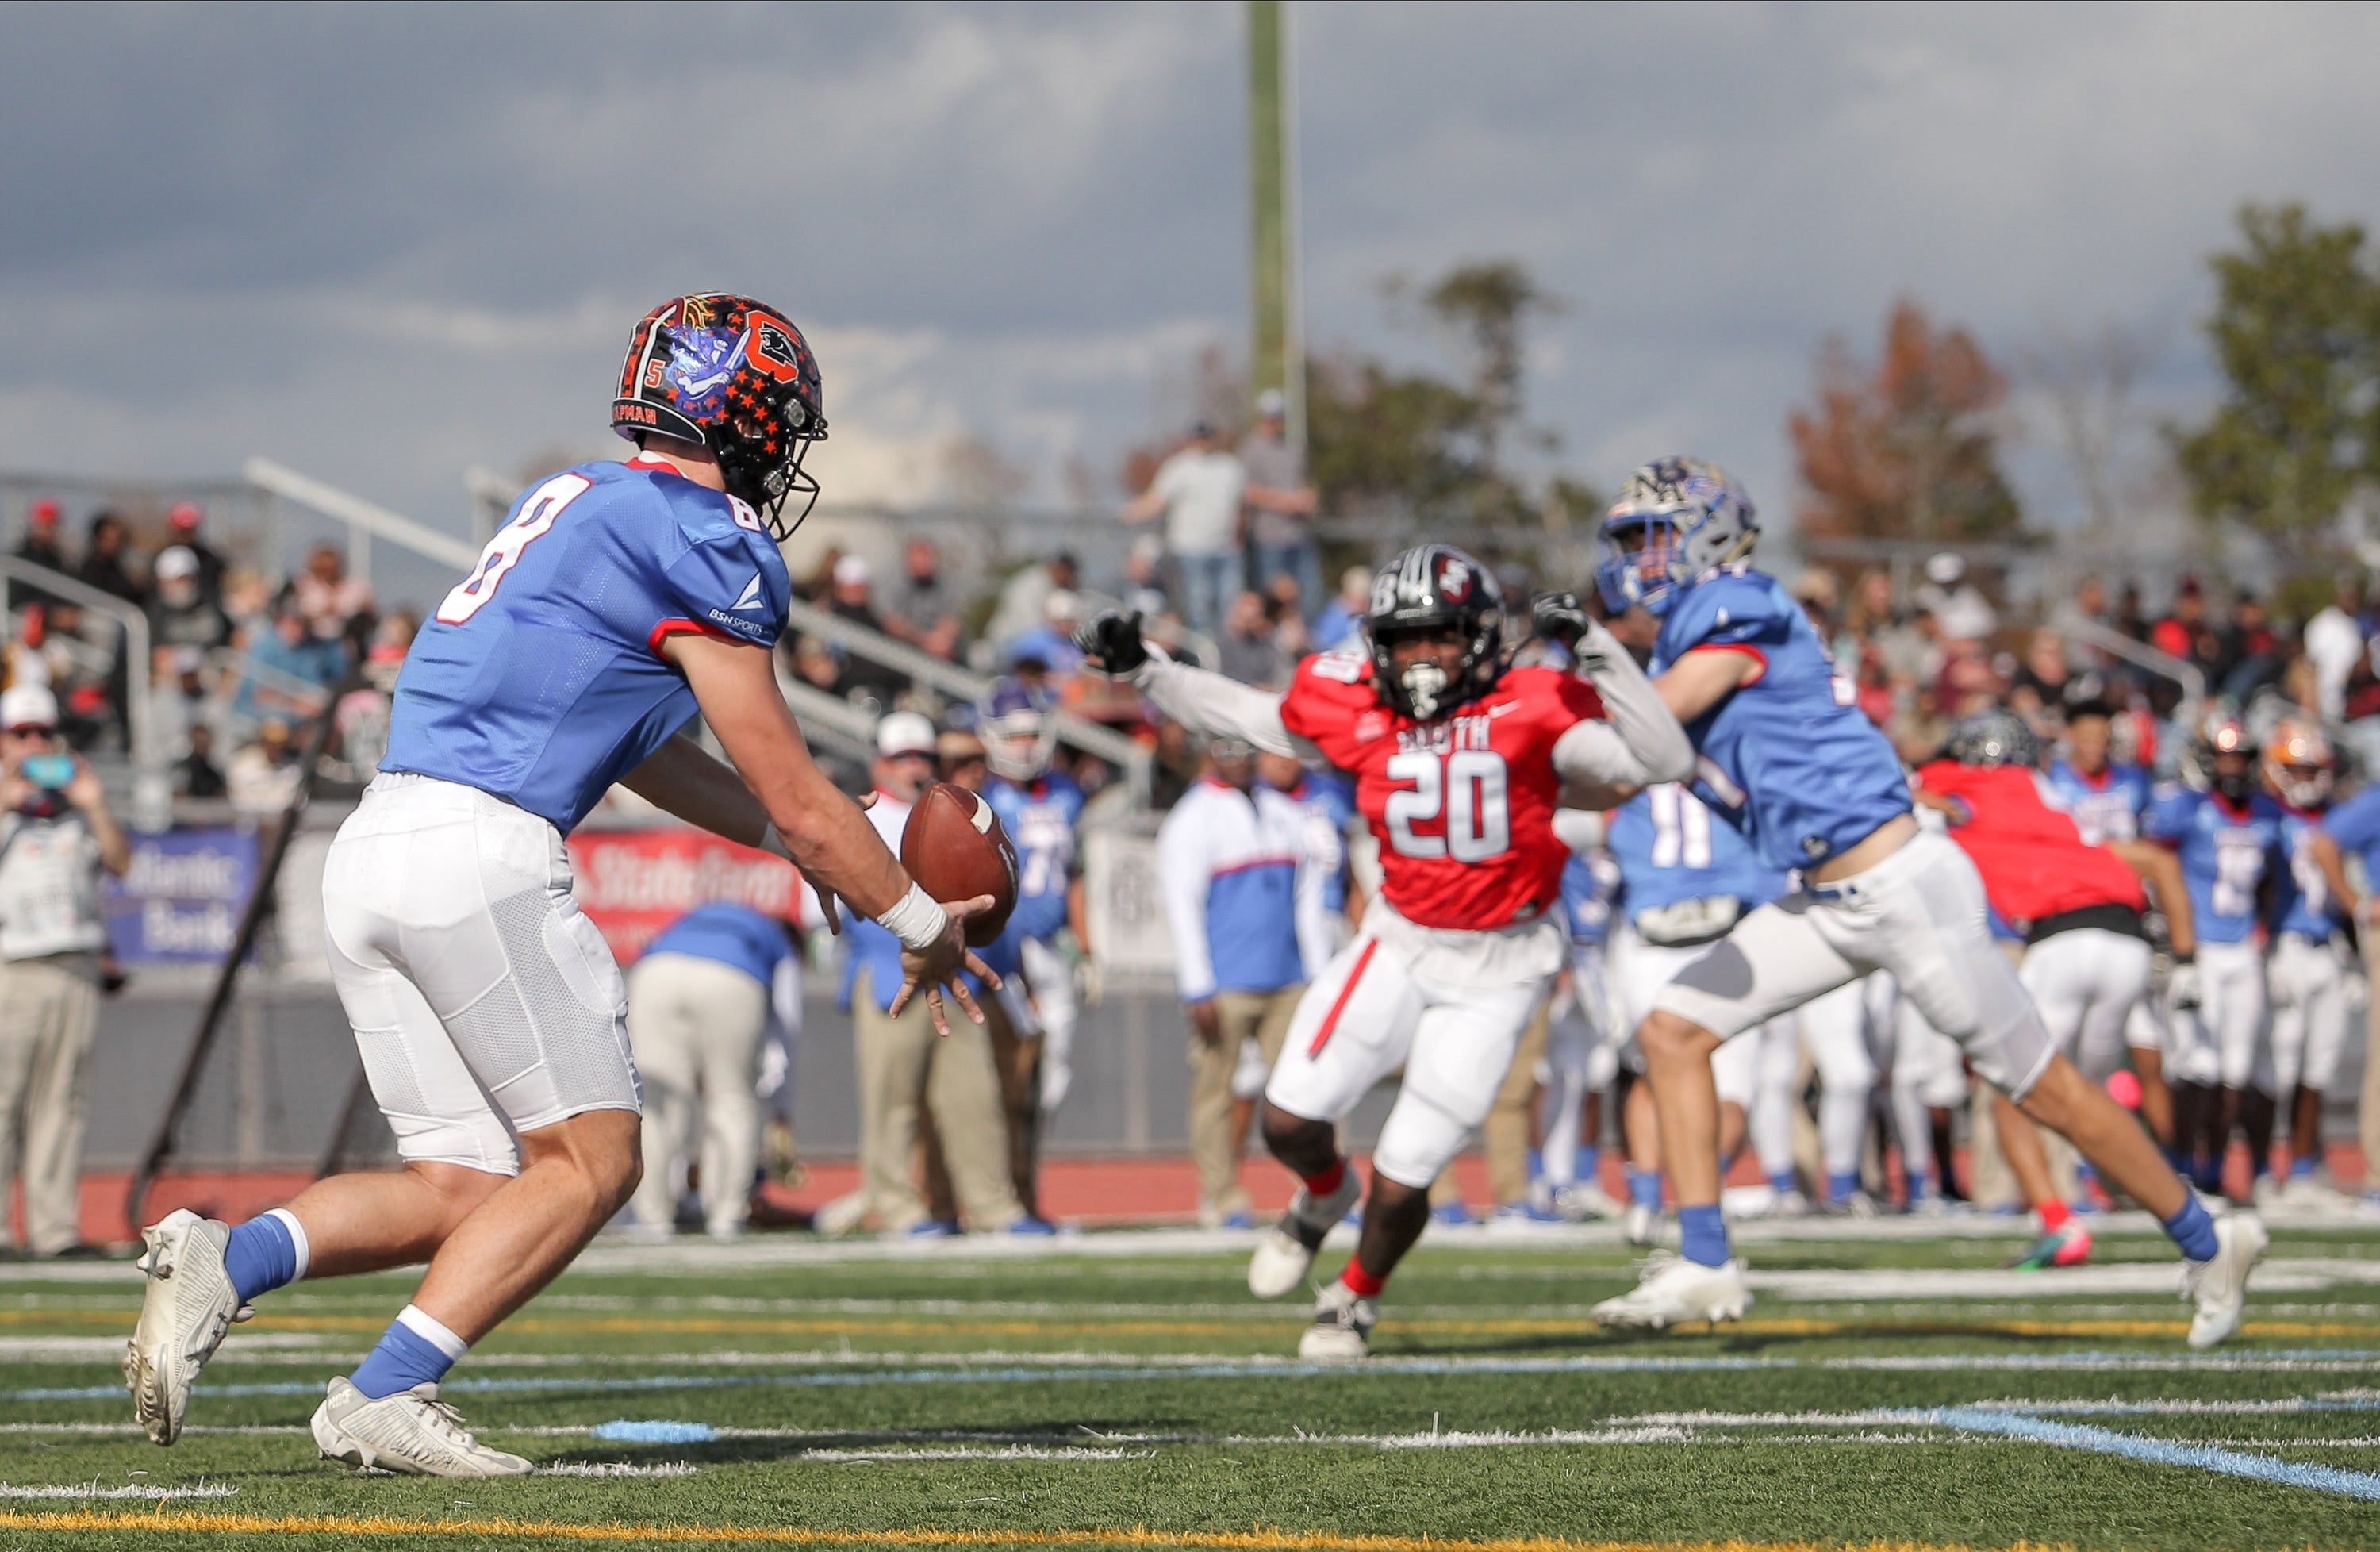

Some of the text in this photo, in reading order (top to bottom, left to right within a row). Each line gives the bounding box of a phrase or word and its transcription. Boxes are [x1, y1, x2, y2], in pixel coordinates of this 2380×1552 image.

[644, 358, 666, 388] 5
[724, 492, 762, 532] 8
[434, 471, 594, 626] 8
[709, 608, 762, 635] BSN SPORTS
[1384, 749, 1510, 864] 20
